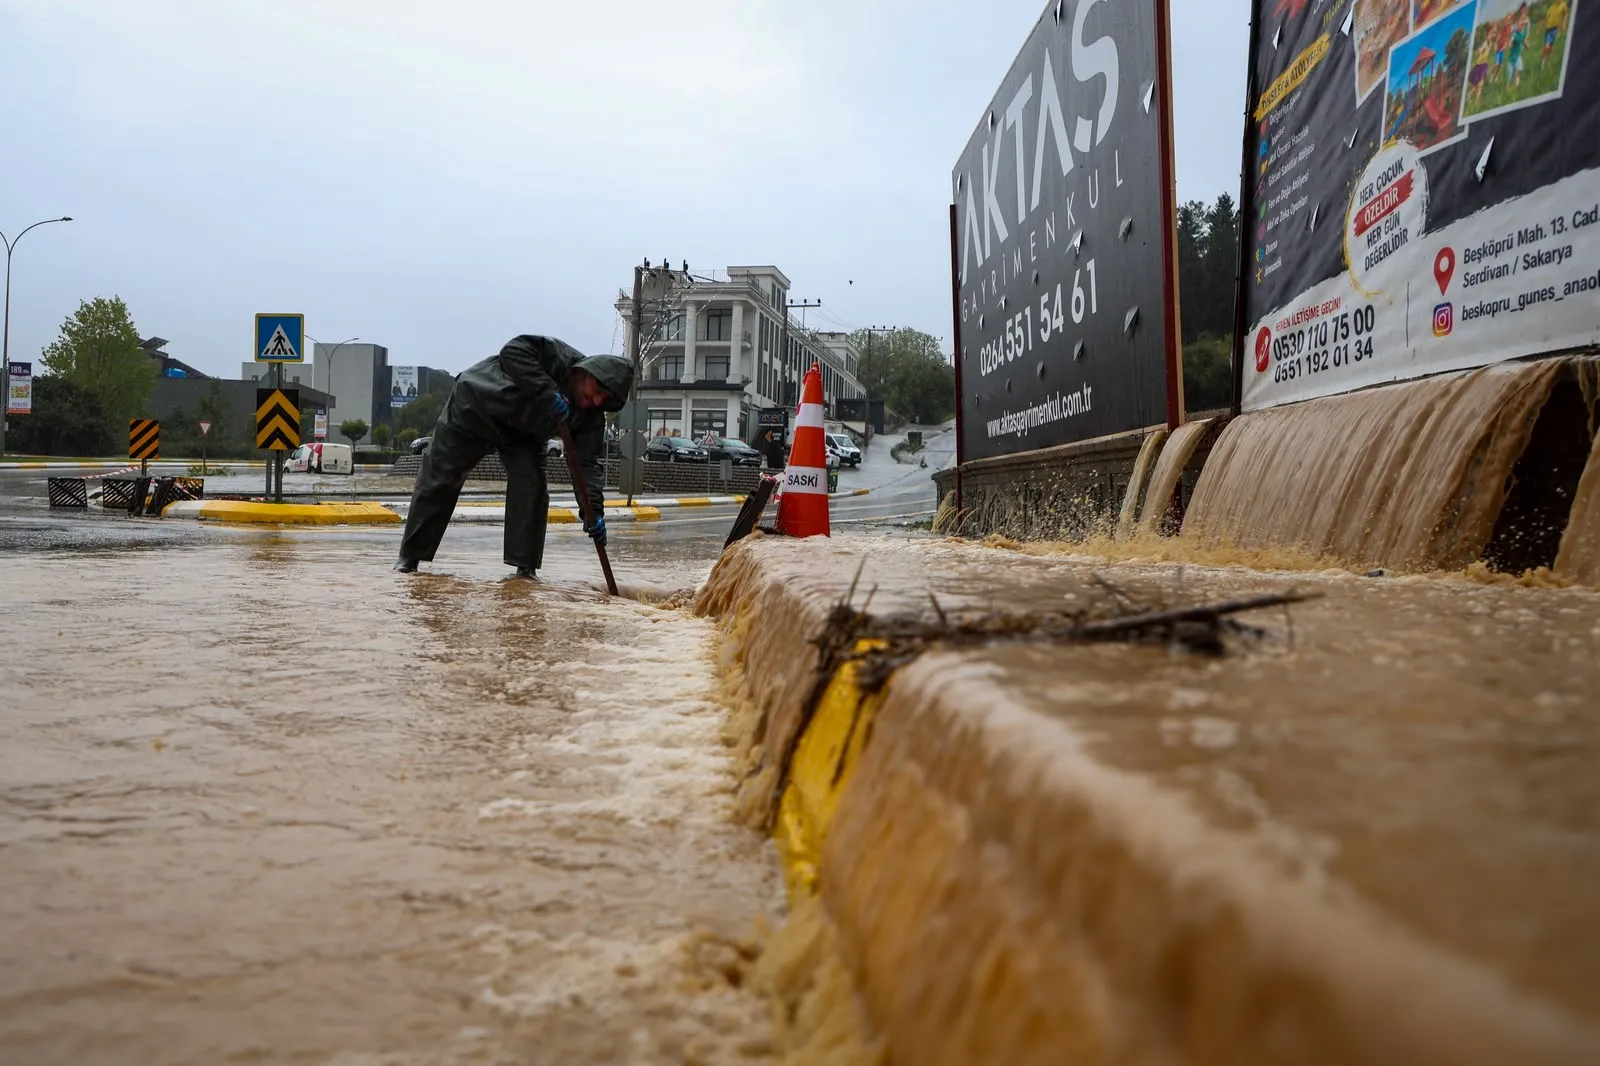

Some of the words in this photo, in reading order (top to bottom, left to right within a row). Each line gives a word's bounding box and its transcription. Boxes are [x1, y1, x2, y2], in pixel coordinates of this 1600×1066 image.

[1360, 182, 1374, 205] HER
[1376, 156, 1404, 193] ÇOCUK
[1364, 187, 1399, 225] ÖZELDİR
[1367, 226, 1382, 249] HER
[1385, 210, 1400, 235] GÜN
[963, 150, 1123, 322] GAYRİMENKUL
[1365, 227, 1408, 272] DEĞERLİDİR
[1463, 234, 1514, 264] Beşköprü
[1517, 223, 1547, 246] Mah.
[1550, 216, 1568, 235] 13.
[1572, 204, 1600, 229] Cad.
[1463, 264, 1509, 288] Serdivan
[1513, 256, 1519, 275] /
[1522, 244, 1573, 270] Sakarya
[980, 335, 1005, 377] 0264
[1006, 305, 1032, 362] 551
[1040, 283, 1064, 343] 54
[1071, 258, 1097, 324] 61
[1273, 330, 1305, 361] 0530
[1308, 321, 1328, 350] 110
[1332, 312, 1350, 343] 75
[1354, 304, 1375, 336] 00
[1291, 305, 1320, 327] İLETİŞİME
[1321, 296, 1341, 318] GEÇİN!
[1275, 358, 1302, 383] 0551
[1306, 349, 1329, 375] 192
[1333, 344, 1349, 367] 01
[1354, 336, 1374, 362] 34
[986, 381, 1092, 438] www.aktasgayrimenkul.com.tr
[787, 474, 819, 488] SASKİ
